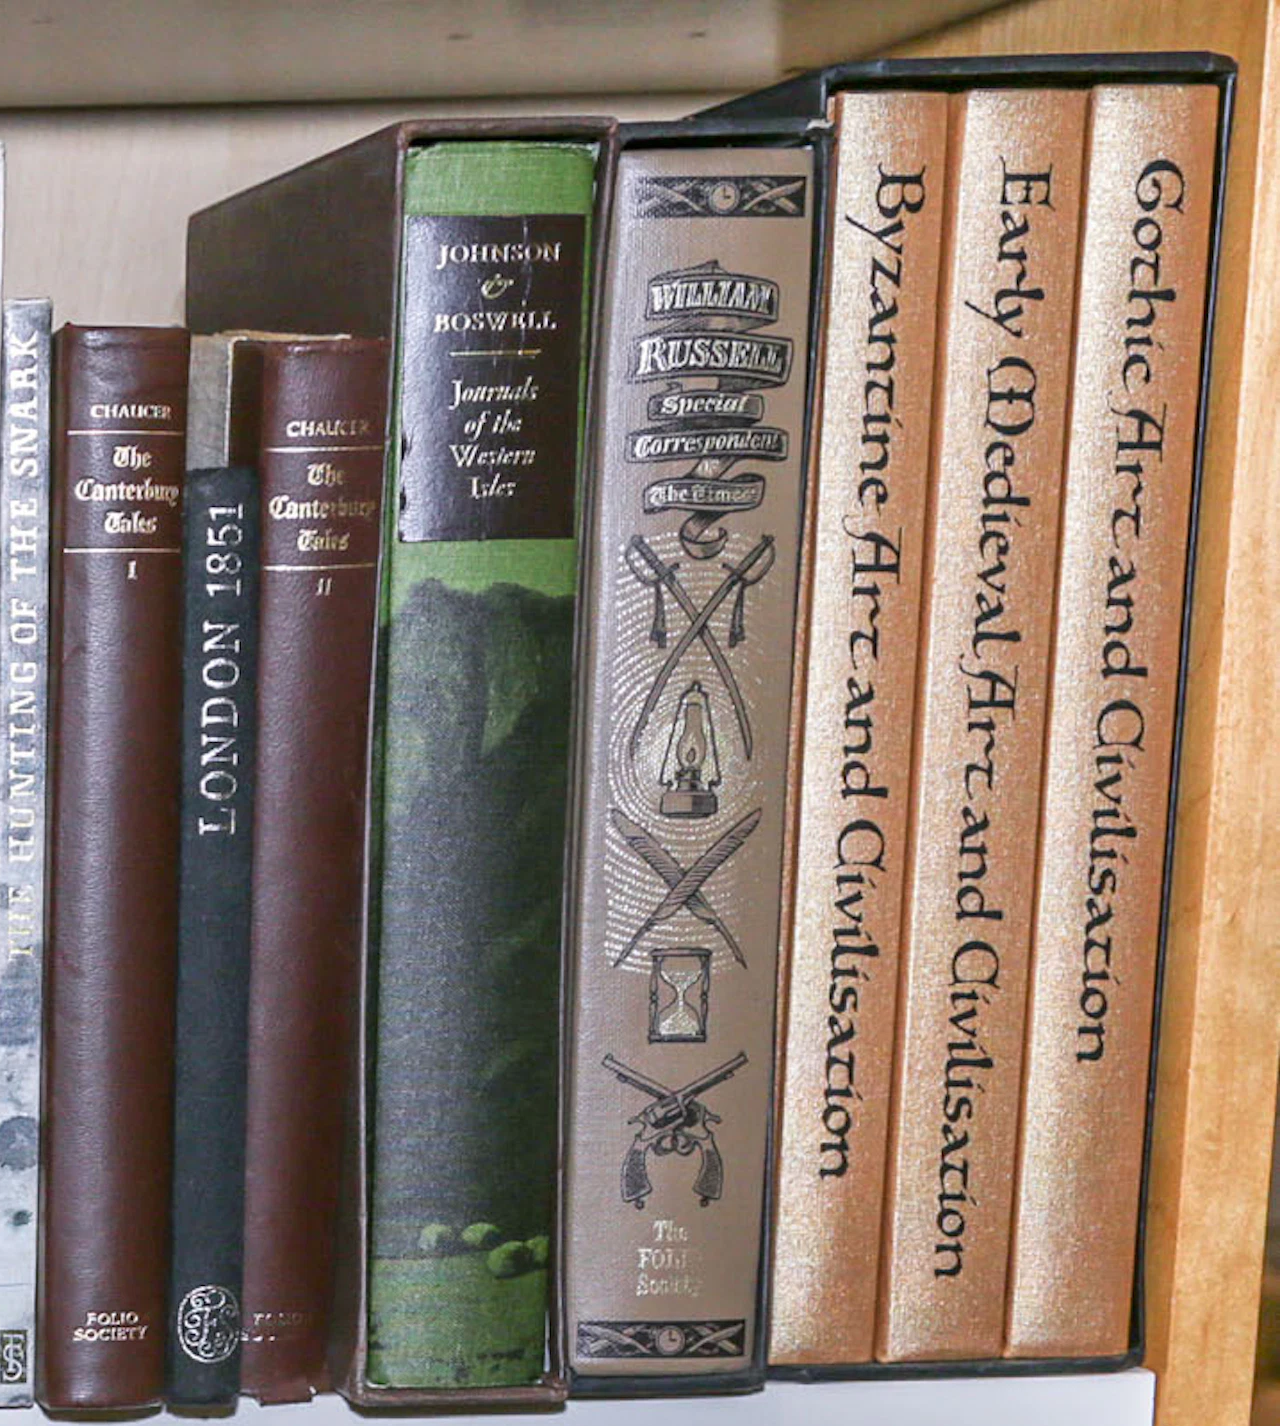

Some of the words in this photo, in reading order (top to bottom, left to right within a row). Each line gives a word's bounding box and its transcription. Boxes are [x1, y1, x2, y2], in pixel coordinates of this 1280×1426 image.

[436, 242, 563, 269] JOHNSON
[652, 281, 771, 314] WILLIAM
[965, 155, 1055, 338] Early
[1122, 158, 1186, 395] Gothic
[434, 311, 558, 332] BOSWELL
[638, 338, 782, 374] RUSSELL
[846, 161, 927, 510] Byzantine
[10, 330, 39, 478] SNARK
[449, 376, 539, 410] Journals
[464, 410, 488, 435] of
[636, 432, 779, 458] Correspondent
[661, 393, 749, 417] Special
[975, 355, 1038, 660] Medieval
[1105, 391, 1168, 549] Art
[10, 498, 39, 582] THE
[207, 503, 244, 597] 1851
[845, 513, 902, 670] Art
[10, 598, 39, 645] OF
[1100, 554, 1149, 680] and
[8, 661, 38, 863] HUNTING
[198, 621, 241, 836] LONDON
[843, 676, 889, 799] and
[959, 654, 1018, 799] Art
[955, 806, 1004, 922] and
[1076, 698, 1146, 1063] Civilisation
[821, 817, 887, 1179] Civilisation
[934, 938, 1000, 1279] Civilisation
